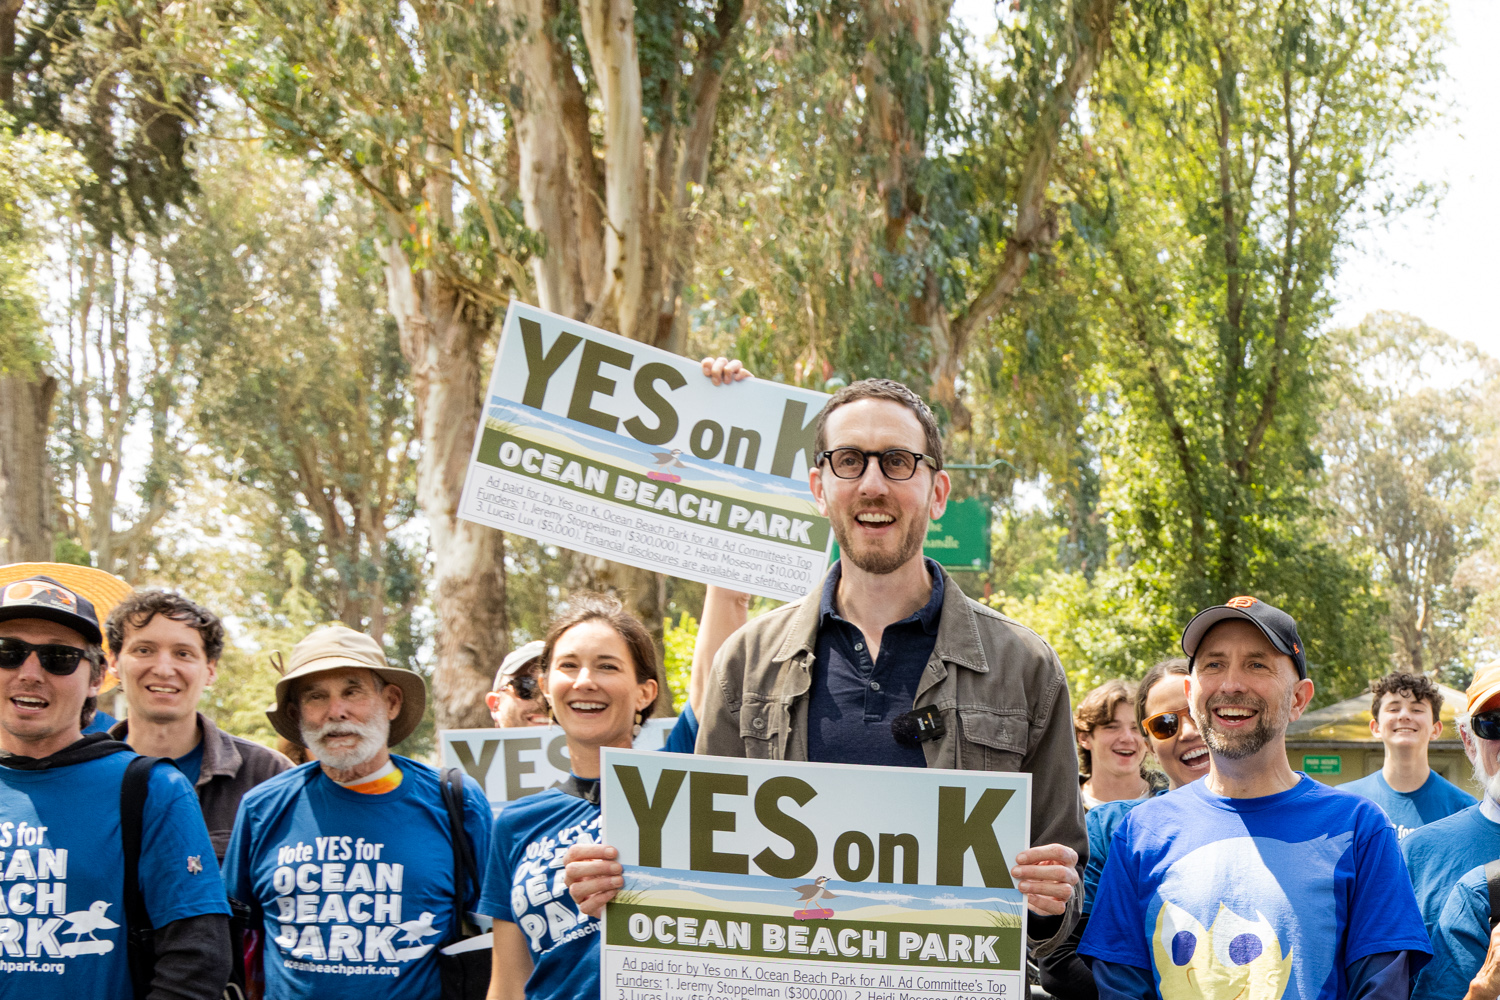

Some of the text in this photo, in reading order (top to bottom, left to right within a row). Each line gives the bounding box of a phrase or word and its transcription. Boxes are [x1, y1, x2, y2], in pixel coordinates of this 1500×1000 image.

[518, 316, 687, 446] YES
[689, 418, 762, 471] on
[499, 441, 814, 545] OCEAN BEACH PARK
[17, 821, 48, 847] for
[613, 765, 817, 878] YES
[833, 830, 919, 884] on
[936, 786, 1015, 888] K
[277, 836, 384, 866] Vote YES for
[273, 863, 404, 895] OCEAN
[276, 893, 402, 924] BEACH
[275, 925, 400, 962] PARK
[628, 913, 751, 950] OCEAN
[762, 923, 887, 958] BEACH
[898, 931, 999, 964] PARK
[284, 959, 400, 977] oceanbeachpark.org
[622, 956, 1007, 995] Ad paid for by Yes on K, Ocean Beach Park for All. Ad Committee's Top
[615, 972, 662, 989] Funders:
[665, 977, 673, 989] 1.
[676, 977, 714, 996] Jeremy
[716, 980, 780, 997] Stoppelman
[618, 988, 628, 1000] 3.
